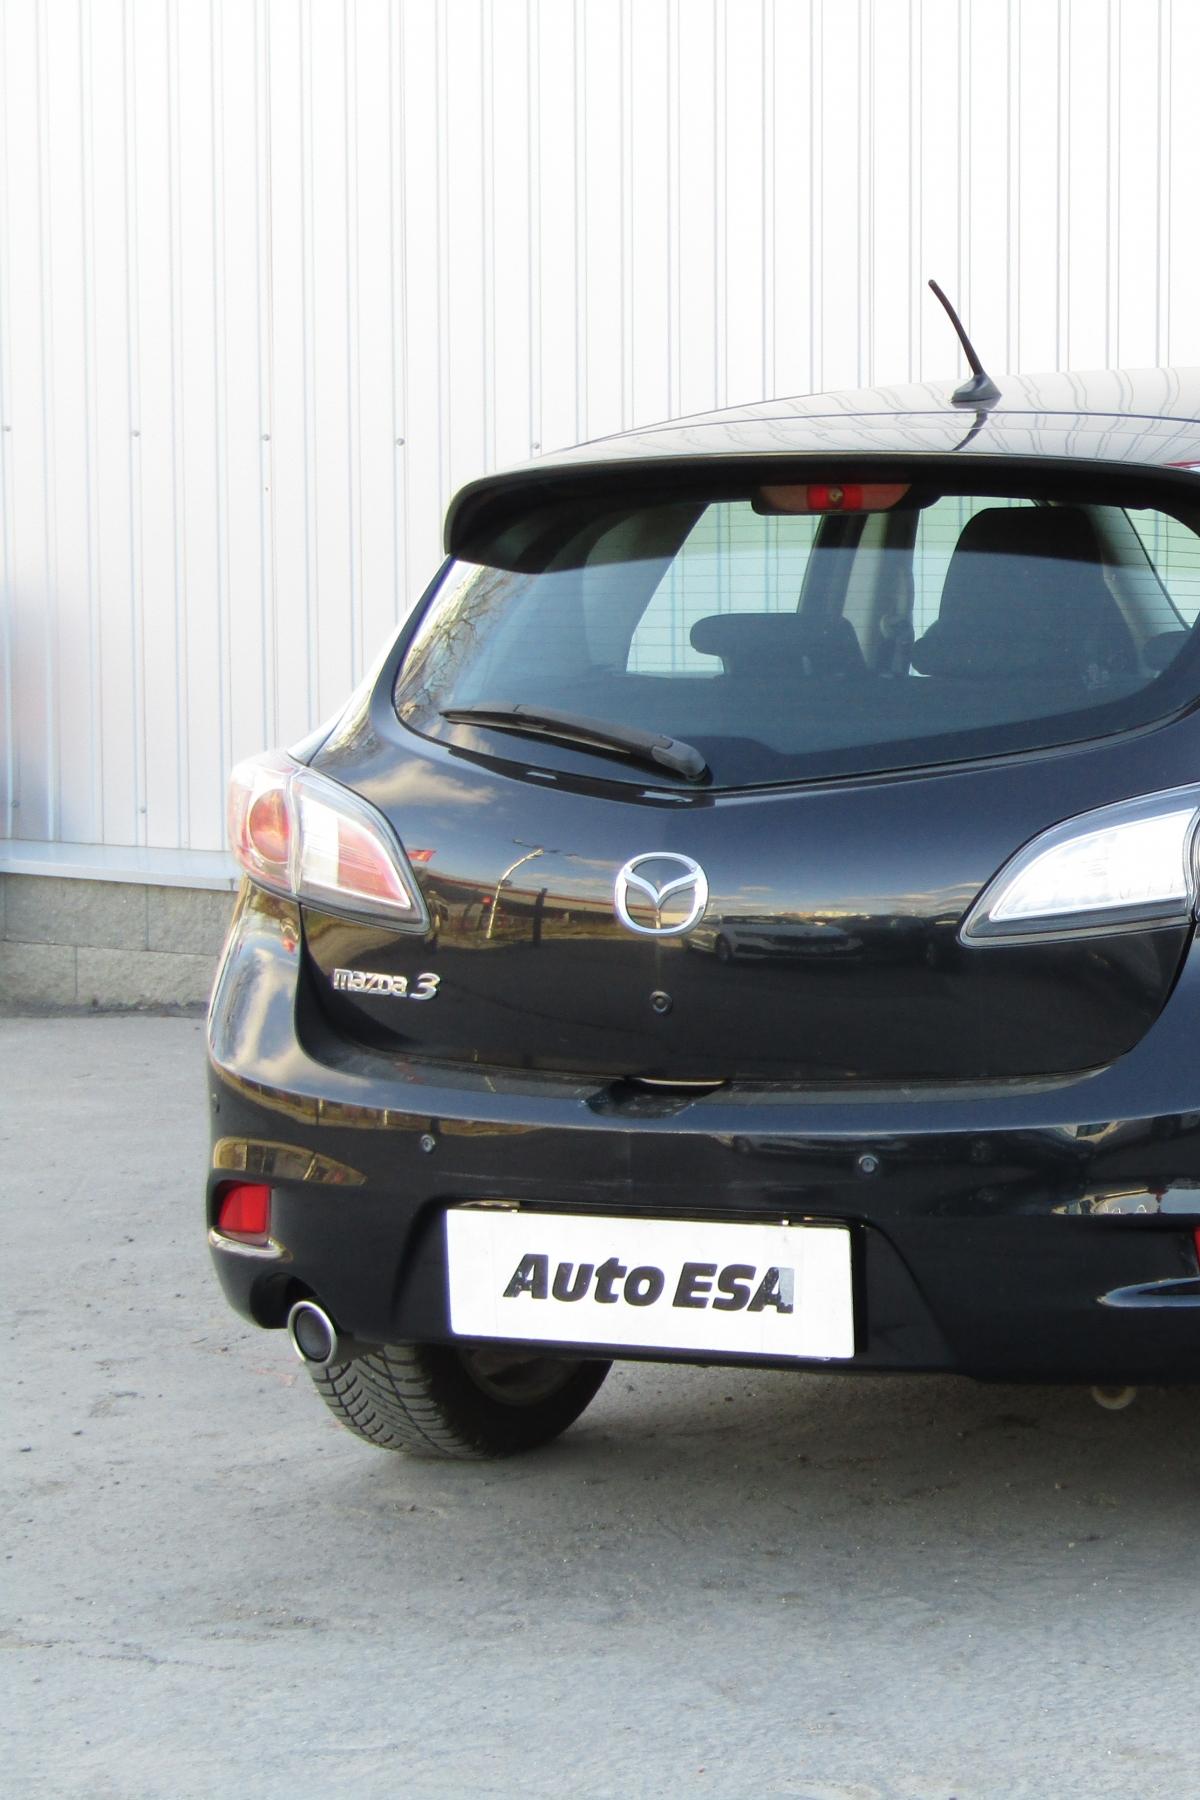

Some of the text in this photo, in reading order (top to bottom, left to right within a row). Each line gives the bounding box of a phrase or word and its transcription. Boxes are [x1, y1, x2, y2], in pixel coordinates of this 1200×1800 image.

[409, 972, 440, 1000] 3
[503, 1253, 795, 1314] Auto ESA
